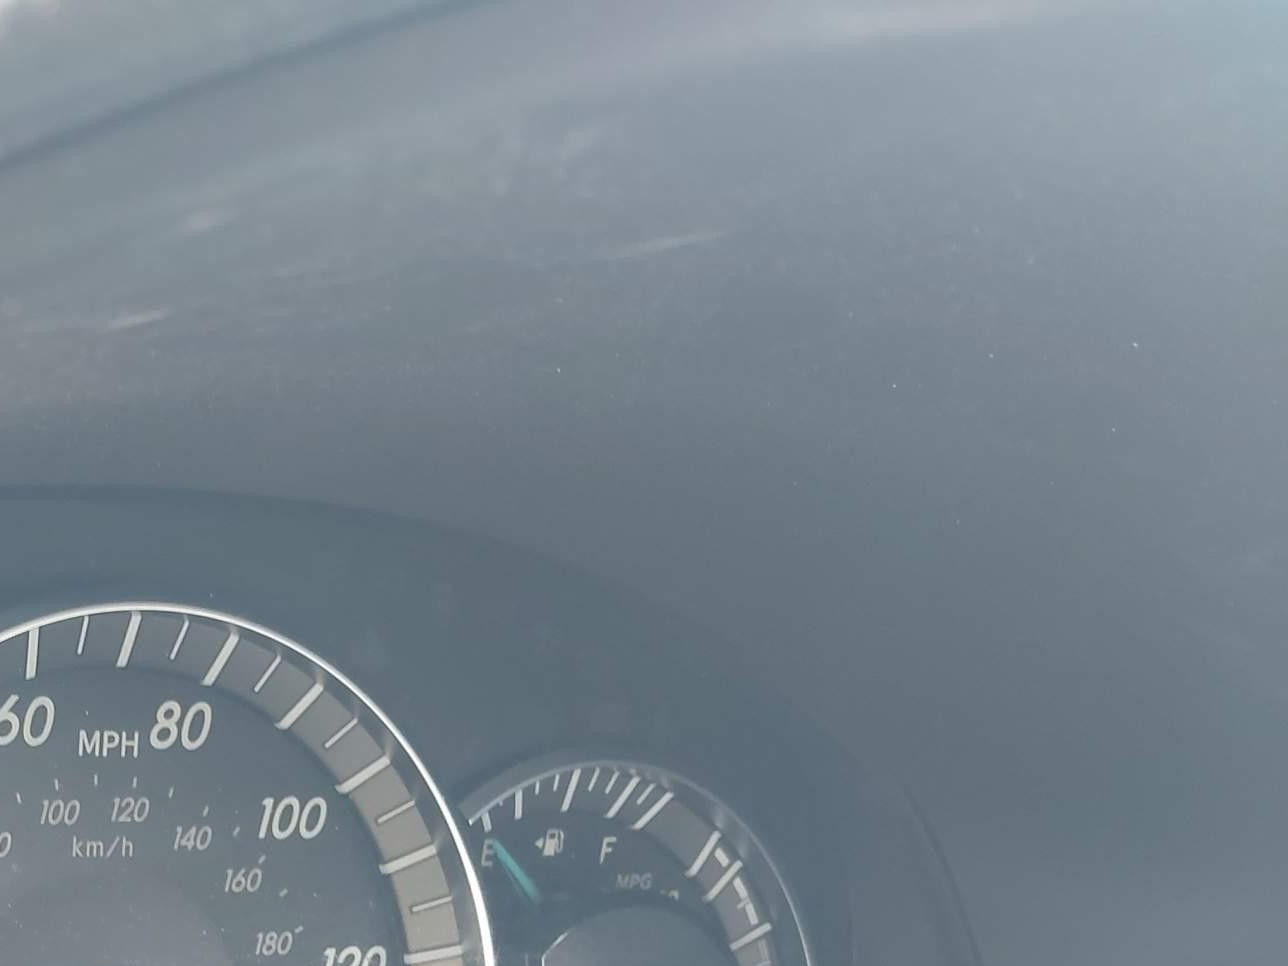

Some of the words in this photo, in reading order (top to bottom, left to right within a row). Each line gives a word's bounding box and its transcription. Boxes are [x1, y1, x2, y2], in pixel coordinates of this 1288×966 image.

[149, 701, 211, 750] 80
[78, 729, 140, 758] MPH
[40, 799, 80, 825] 100
[111, 797, 150, 823] 120
[259, 797, 327, 838] 100
[72, 835, 135, 858] km/h
[173, 826, 212, 851] 140
[599, 837, 617, 865] F
[481, 838, 495, 867] E
[224, 869, 262, 892] 160
[616, 874, 653, 890] MPG
[255, 932, 294, 955] 180
